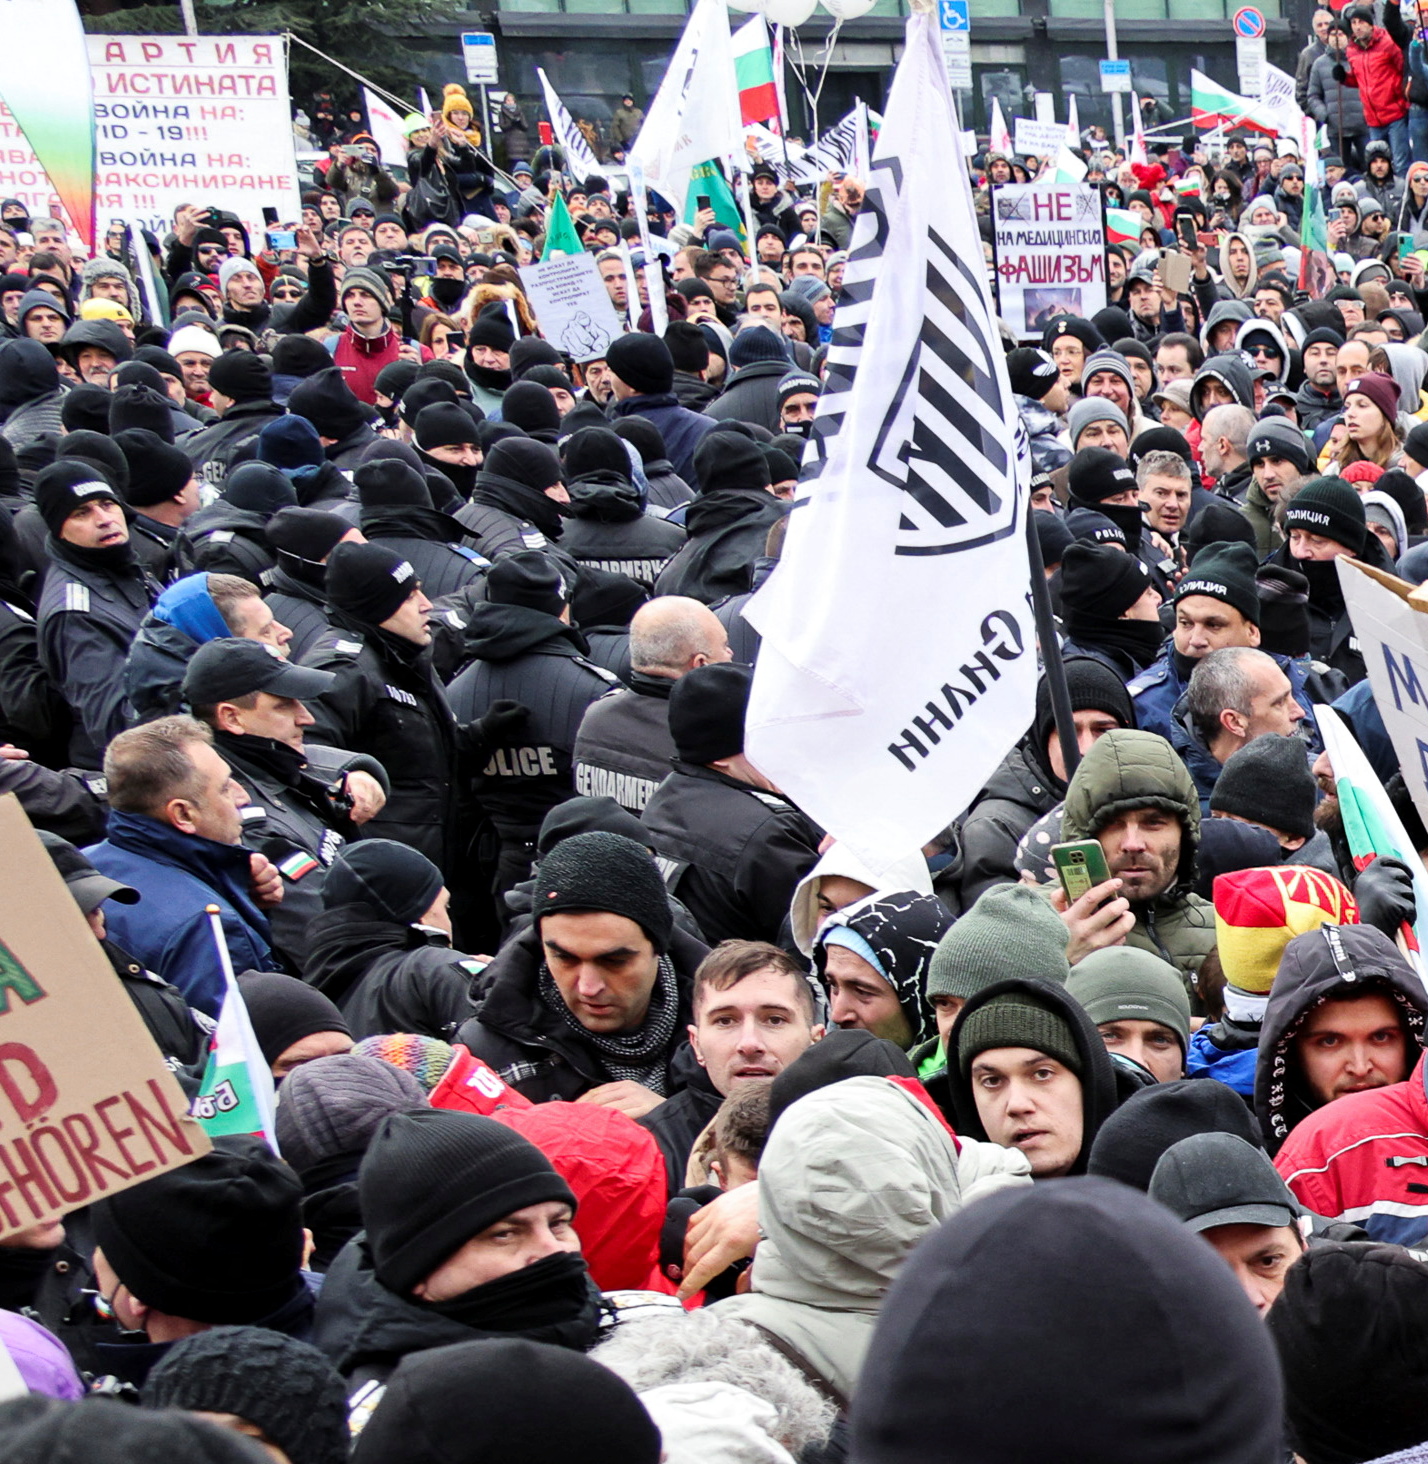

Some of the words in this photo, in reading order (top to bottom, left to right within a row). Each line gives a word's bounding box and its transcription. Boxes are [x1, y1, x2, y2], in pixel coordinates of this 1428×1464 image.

[105, 42, 273, 64] АРТИЯ
[106, 72, 277, 96] ИСТИНАТА
[95, 124, 128, 140] ID
[99, 148, 196, 168] ВОЙНА
[1033, 193, 1072, 221] НЕ
[997, 231, 1013, 246] НА
[1016, 229, 1102, 248] МЕДИЦИНСКИЯ
[998, 254, 1105, 284] ФАШИЗЪМ
[1094, 528, 1126, 541] POLIC
[1179, 580, 1228, 597] ОЛИЦИЯ
